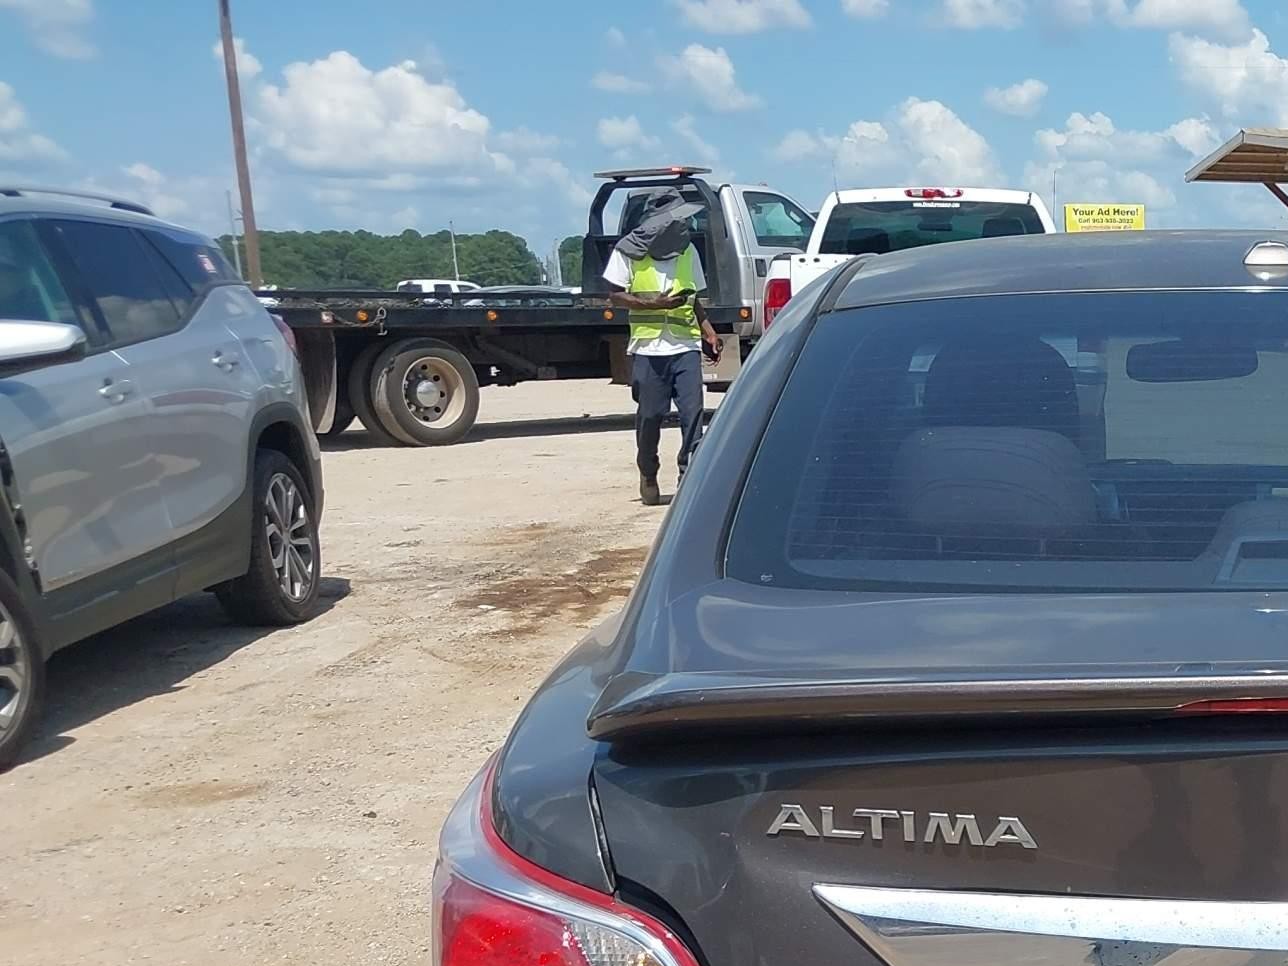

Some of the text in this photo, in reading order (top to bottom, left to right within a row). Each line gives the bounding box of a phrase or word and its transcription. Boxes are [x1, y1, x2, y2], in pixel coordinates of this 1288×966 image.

[1073, 208, 1139, 216] Your Ad Here!
[766, 804, 1039, 849] ALTIMA
